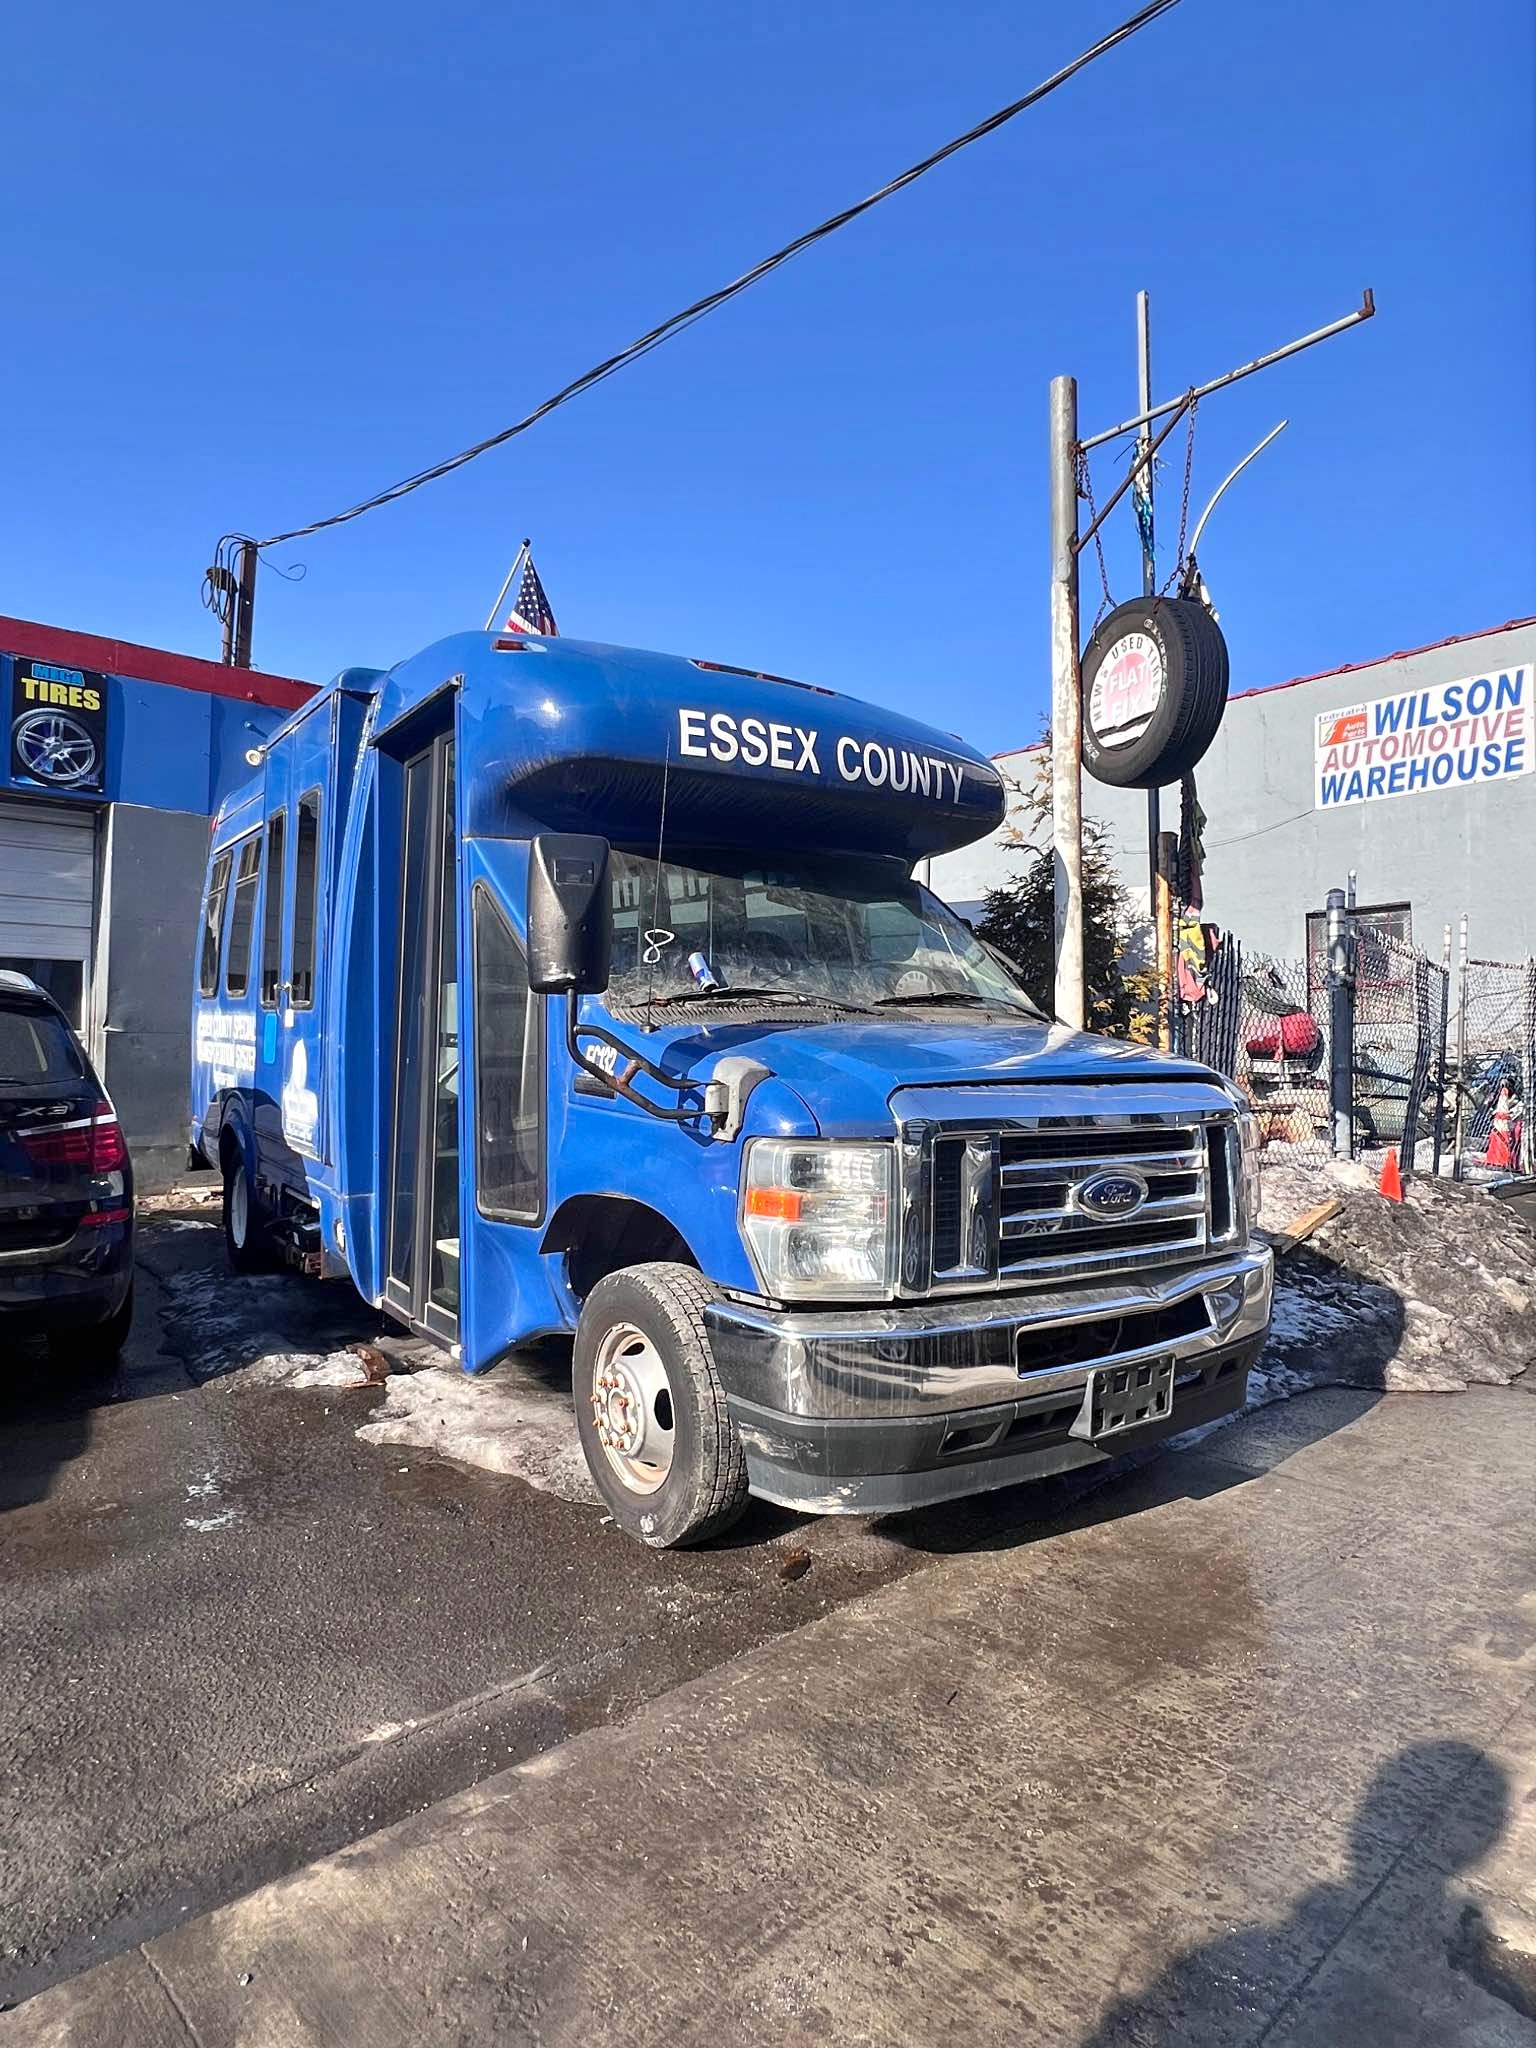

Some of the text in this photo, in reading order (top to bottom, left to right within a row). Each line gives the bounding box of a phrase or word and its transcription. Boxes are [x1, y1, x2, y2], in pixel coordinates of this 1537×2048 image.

[1111, 636, 1143, 660] USED
[21, 677, 101, 711] TIRES
[1109, 662, 1148, 693] FLAT
[1375, 669, 1525, 736] WILSON
[678, 708, 963, 804] ESSEX COUNTY
[1322, 708, 1525, 774] AUTOMOTIVE
[1321, 737, 1526, 805] WAREHOUSE
[642, 928, 675, 964] 8
[16, 1105, 69, 1117] X3
[1100, 1183, 1133, 1205] Ford
